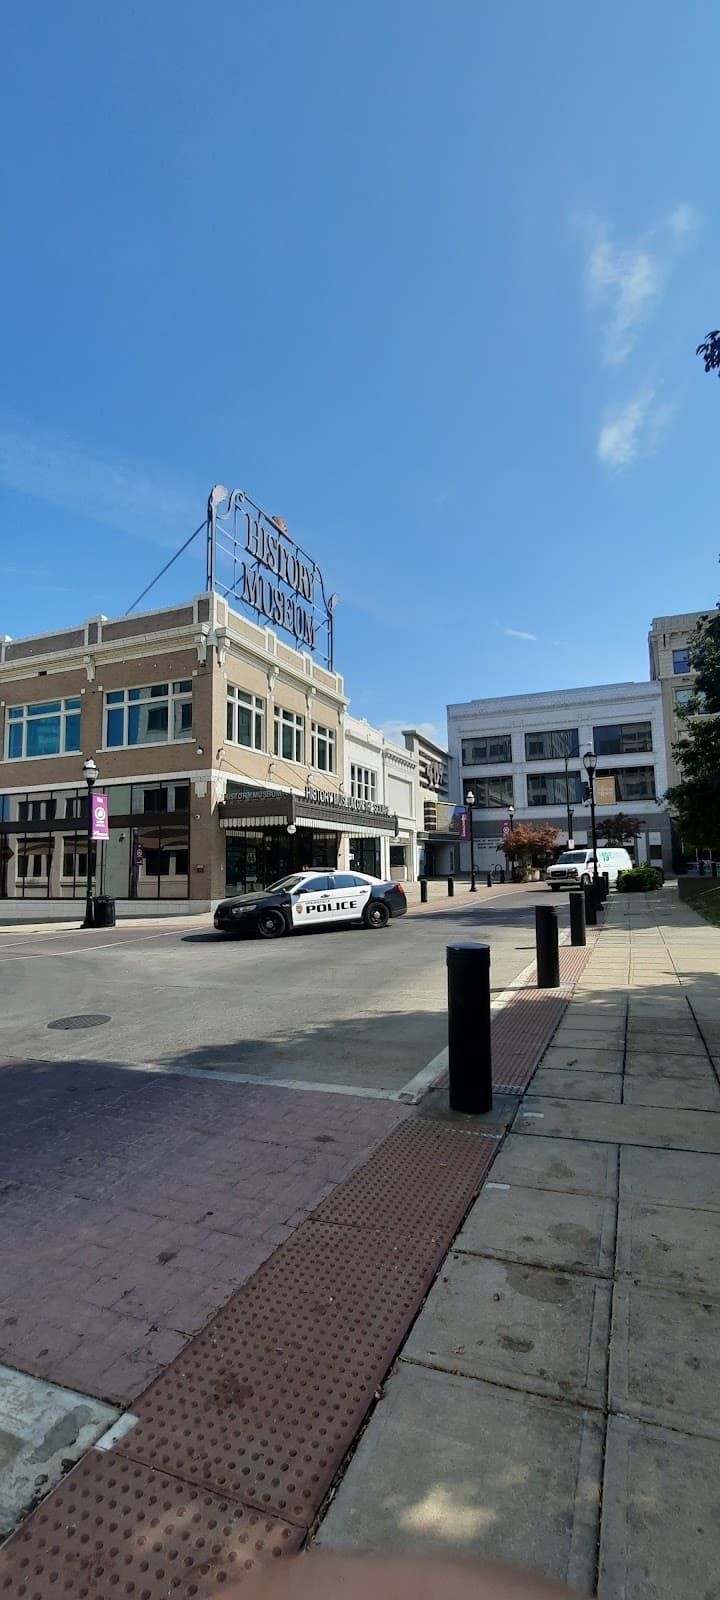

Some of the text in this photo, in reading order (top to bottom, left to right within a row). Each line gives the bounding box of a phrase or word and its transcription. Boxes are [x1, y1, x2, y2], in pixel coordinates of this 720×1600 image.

[246, 513, 314, 604] HISTORY
[242, 562, 317, 650] MUSEUM
[224, 790, 282, 800] ISTORY MUSEUM
[304, 786, 334, 805] HISTORY
[306, 900, 358, 914] POLICE
